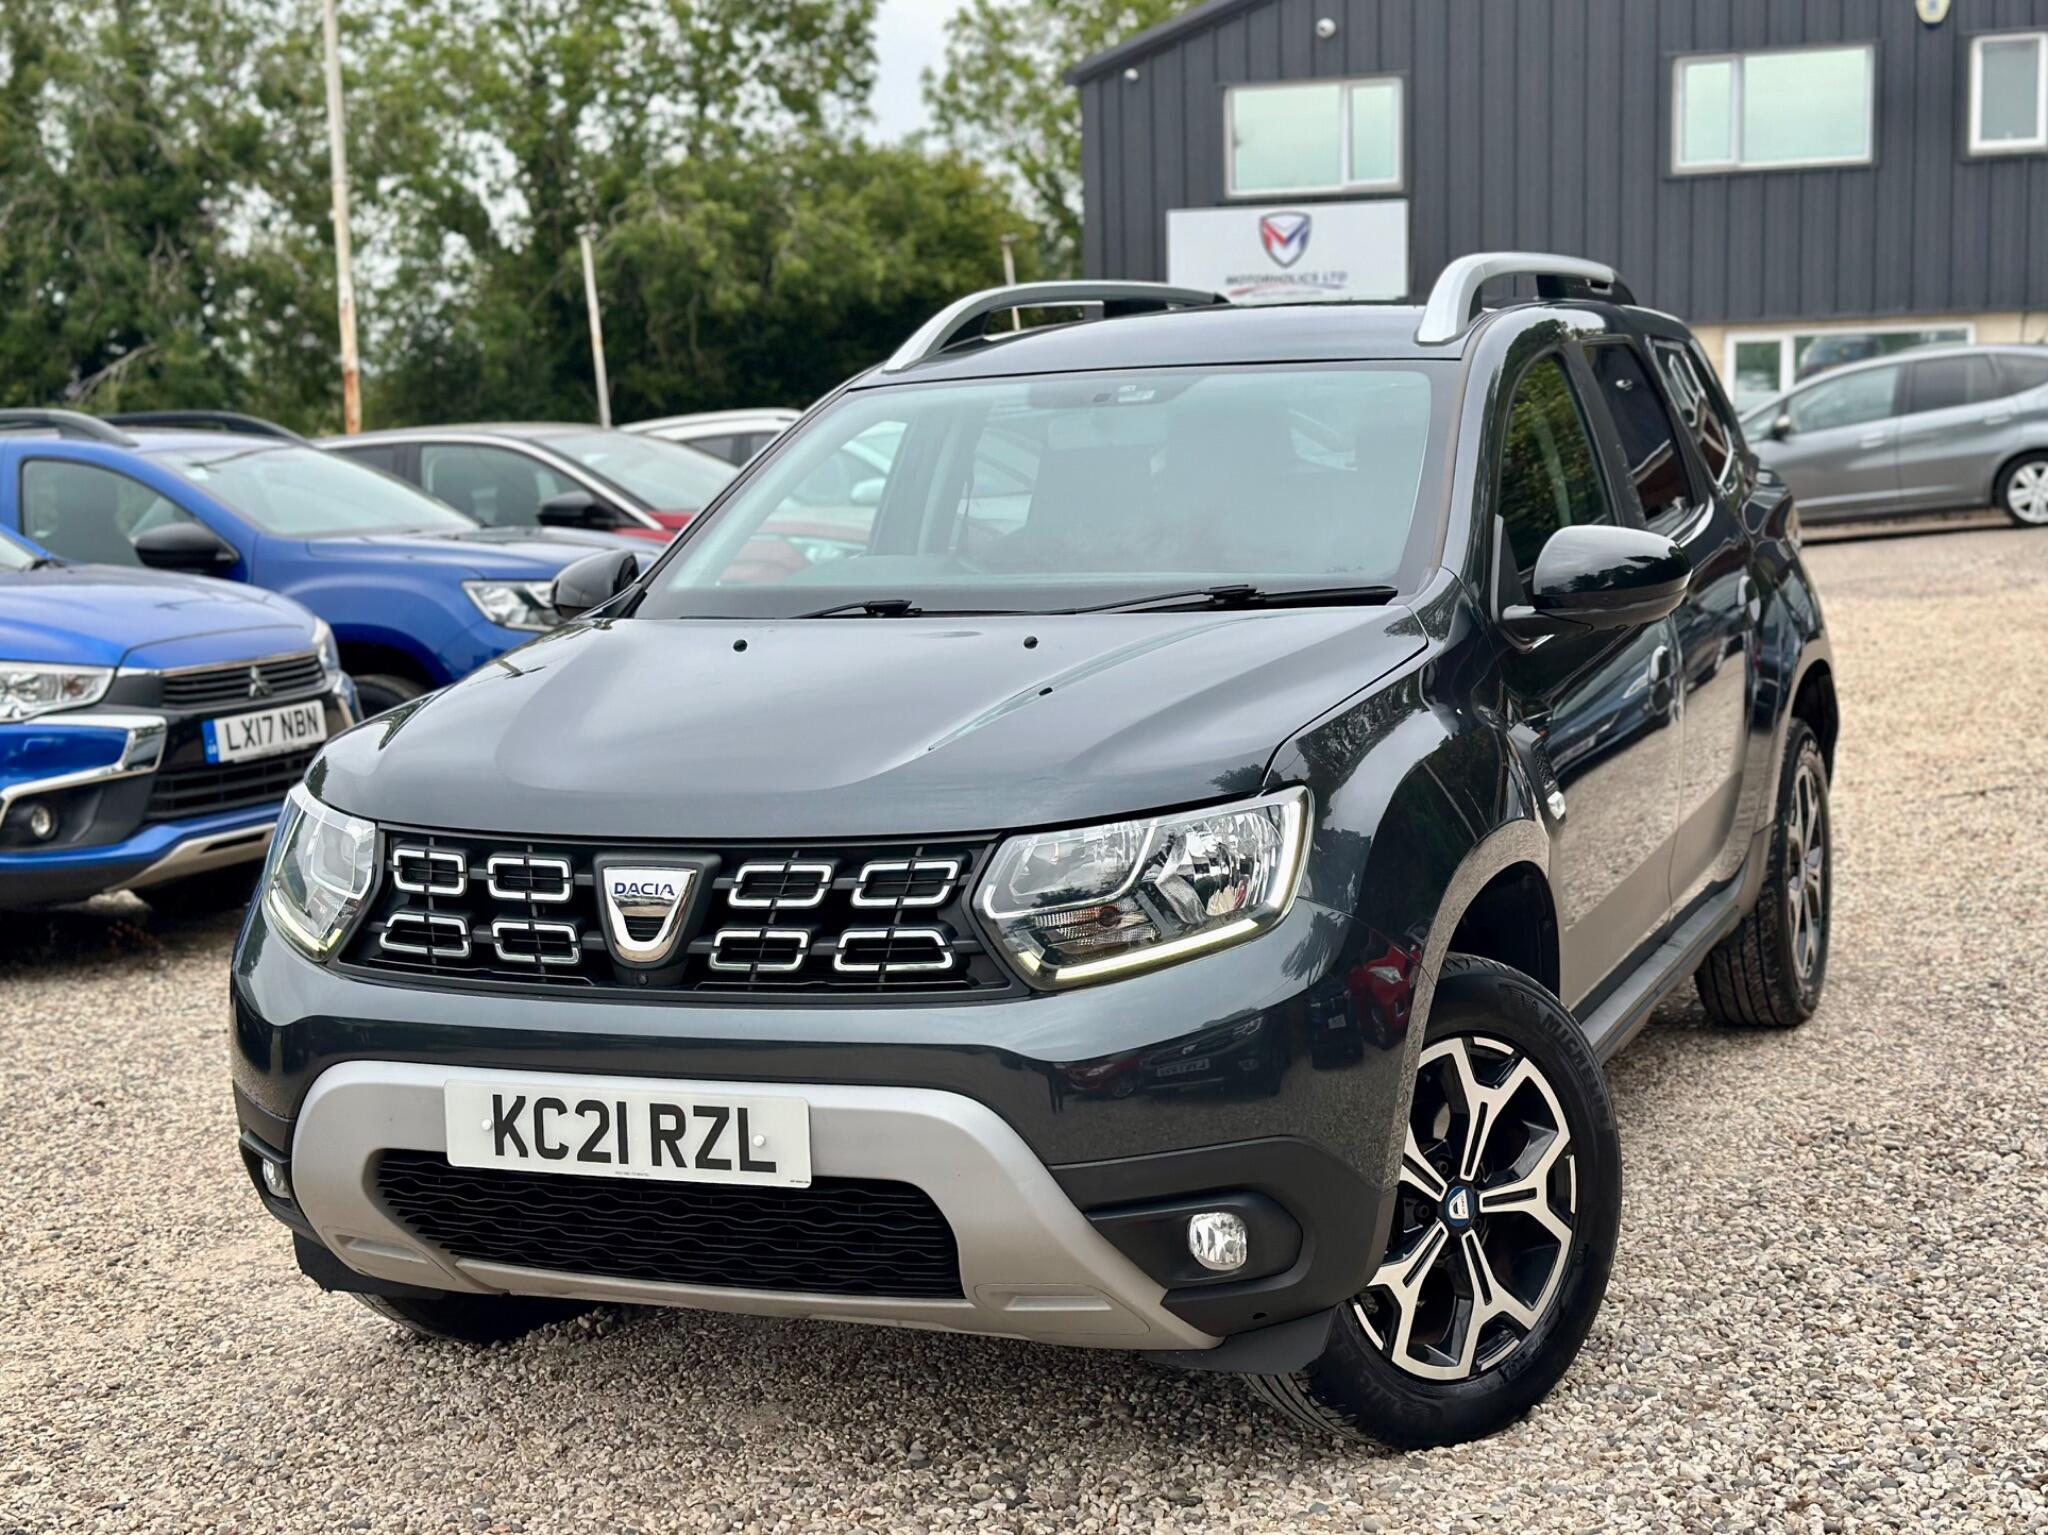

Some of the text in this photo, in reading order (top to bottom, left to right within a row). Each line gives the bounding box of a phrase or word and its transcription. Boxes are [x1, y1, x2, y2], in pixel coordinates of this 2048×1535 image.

[1226, 271, 1348, 286] MOTORHOLICS LTD
[225, 706, 319, 752] LX17 NBN
[613, 882, 676, 897] DACIA
[492, 1094, 778, 1174] KC21 RZL
